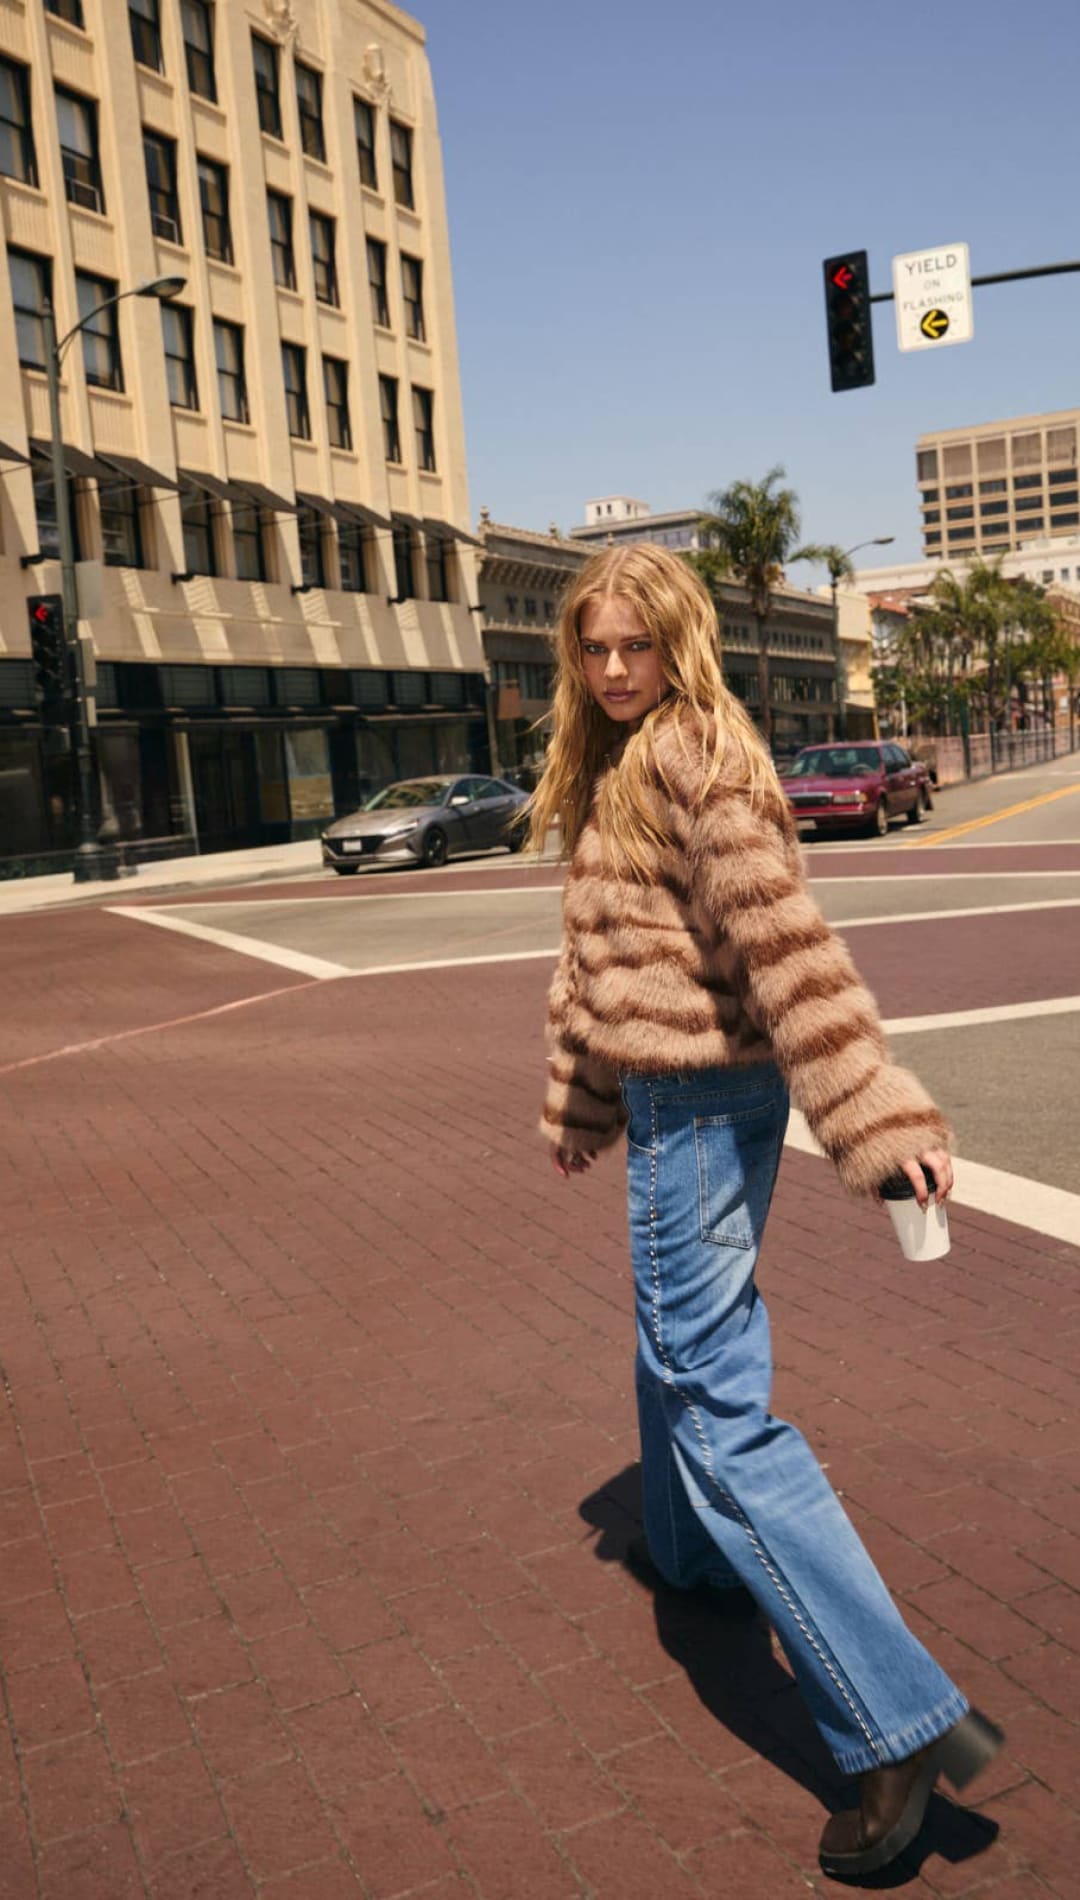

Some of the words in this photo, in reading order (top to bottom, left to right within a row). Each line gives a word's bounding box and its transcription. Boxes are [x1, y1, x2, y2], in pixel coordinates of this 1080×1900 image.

[904, 254, 957, 275] YIELD
[923, 279, 941, 290] ON
[903, 292, 964, 310] FLASHING
